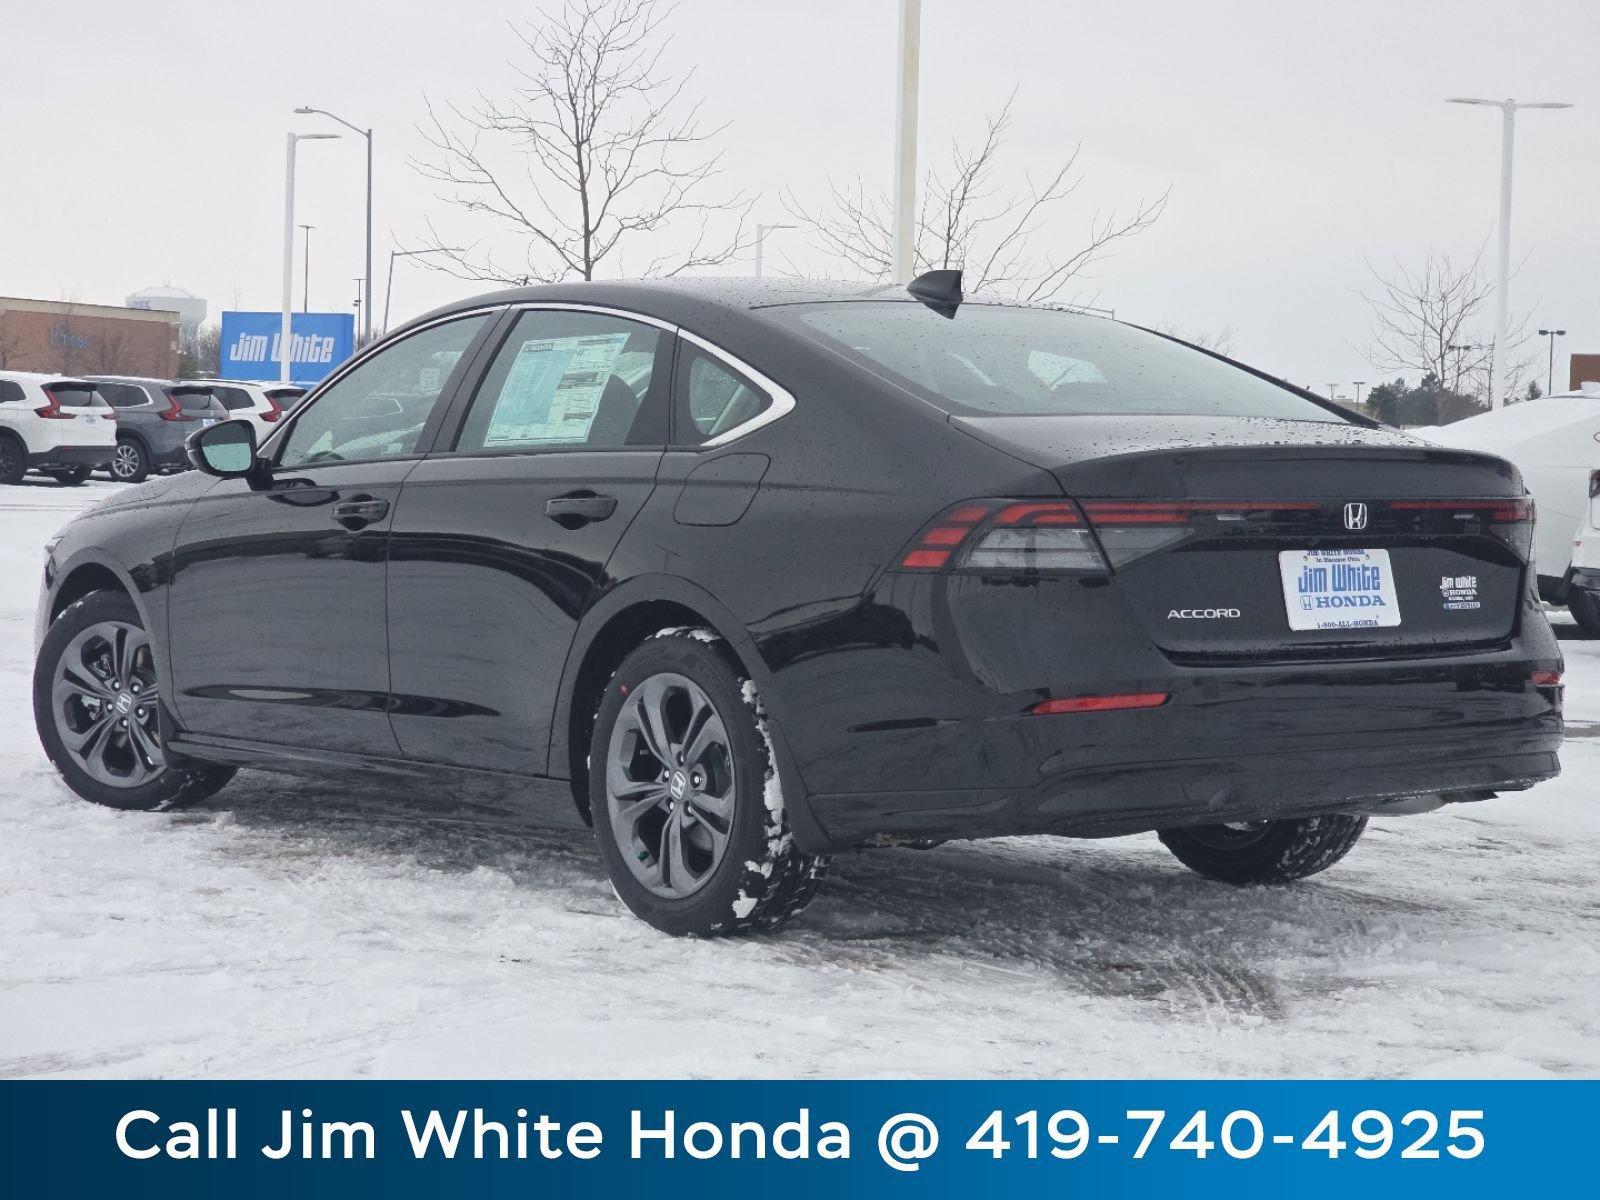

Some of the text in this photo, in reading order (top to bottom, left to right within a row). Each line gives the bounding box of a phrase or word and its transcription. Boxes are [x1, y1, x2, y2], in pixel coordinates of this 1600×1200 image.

[229, 332, 268, 361] Jim
[1298, 564, 1381, 593] Jim White
[1316, 595, 1386, 608] HONDA
[1167, 608, 1241, 619] ACCORD
